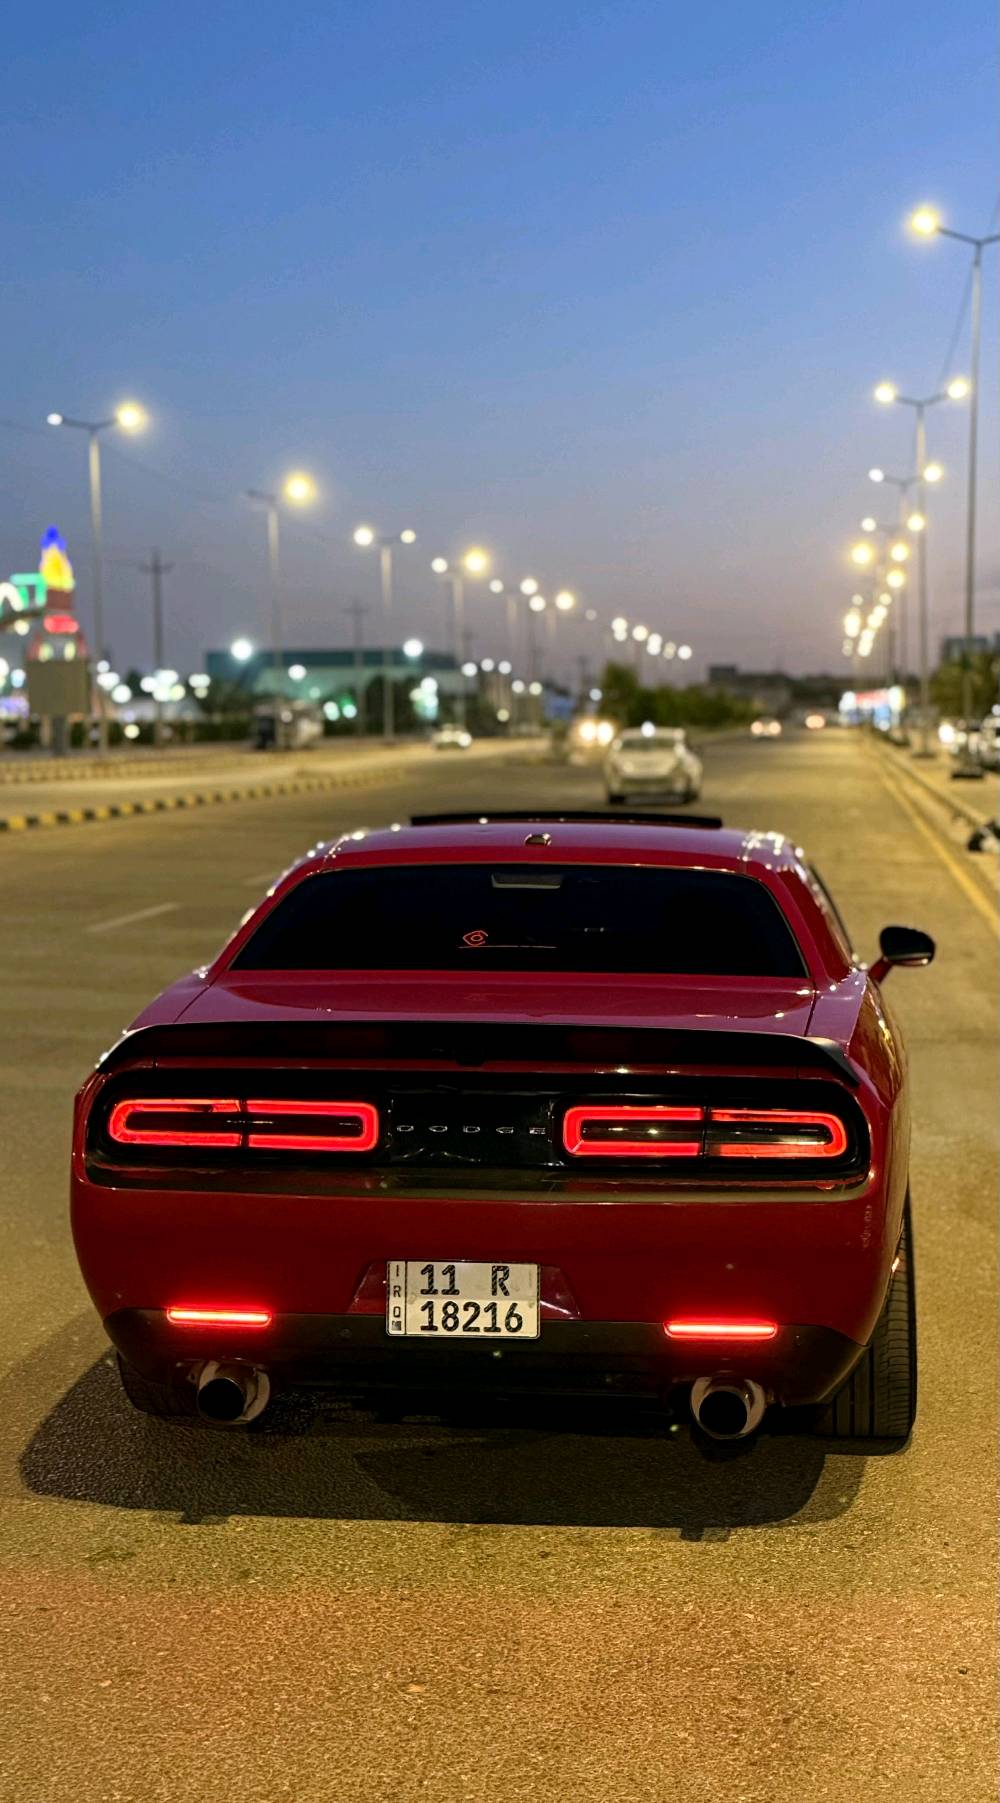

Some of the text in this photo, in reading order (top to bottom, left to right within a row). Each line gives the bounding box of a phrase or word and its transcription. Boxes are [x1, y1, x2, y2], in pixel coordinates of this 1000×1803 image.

[396, 1125, 546, 1135] DODGE
[420, 1264, 510, 1296] 11 R
[420, 1301, 523, 1333] 18216
